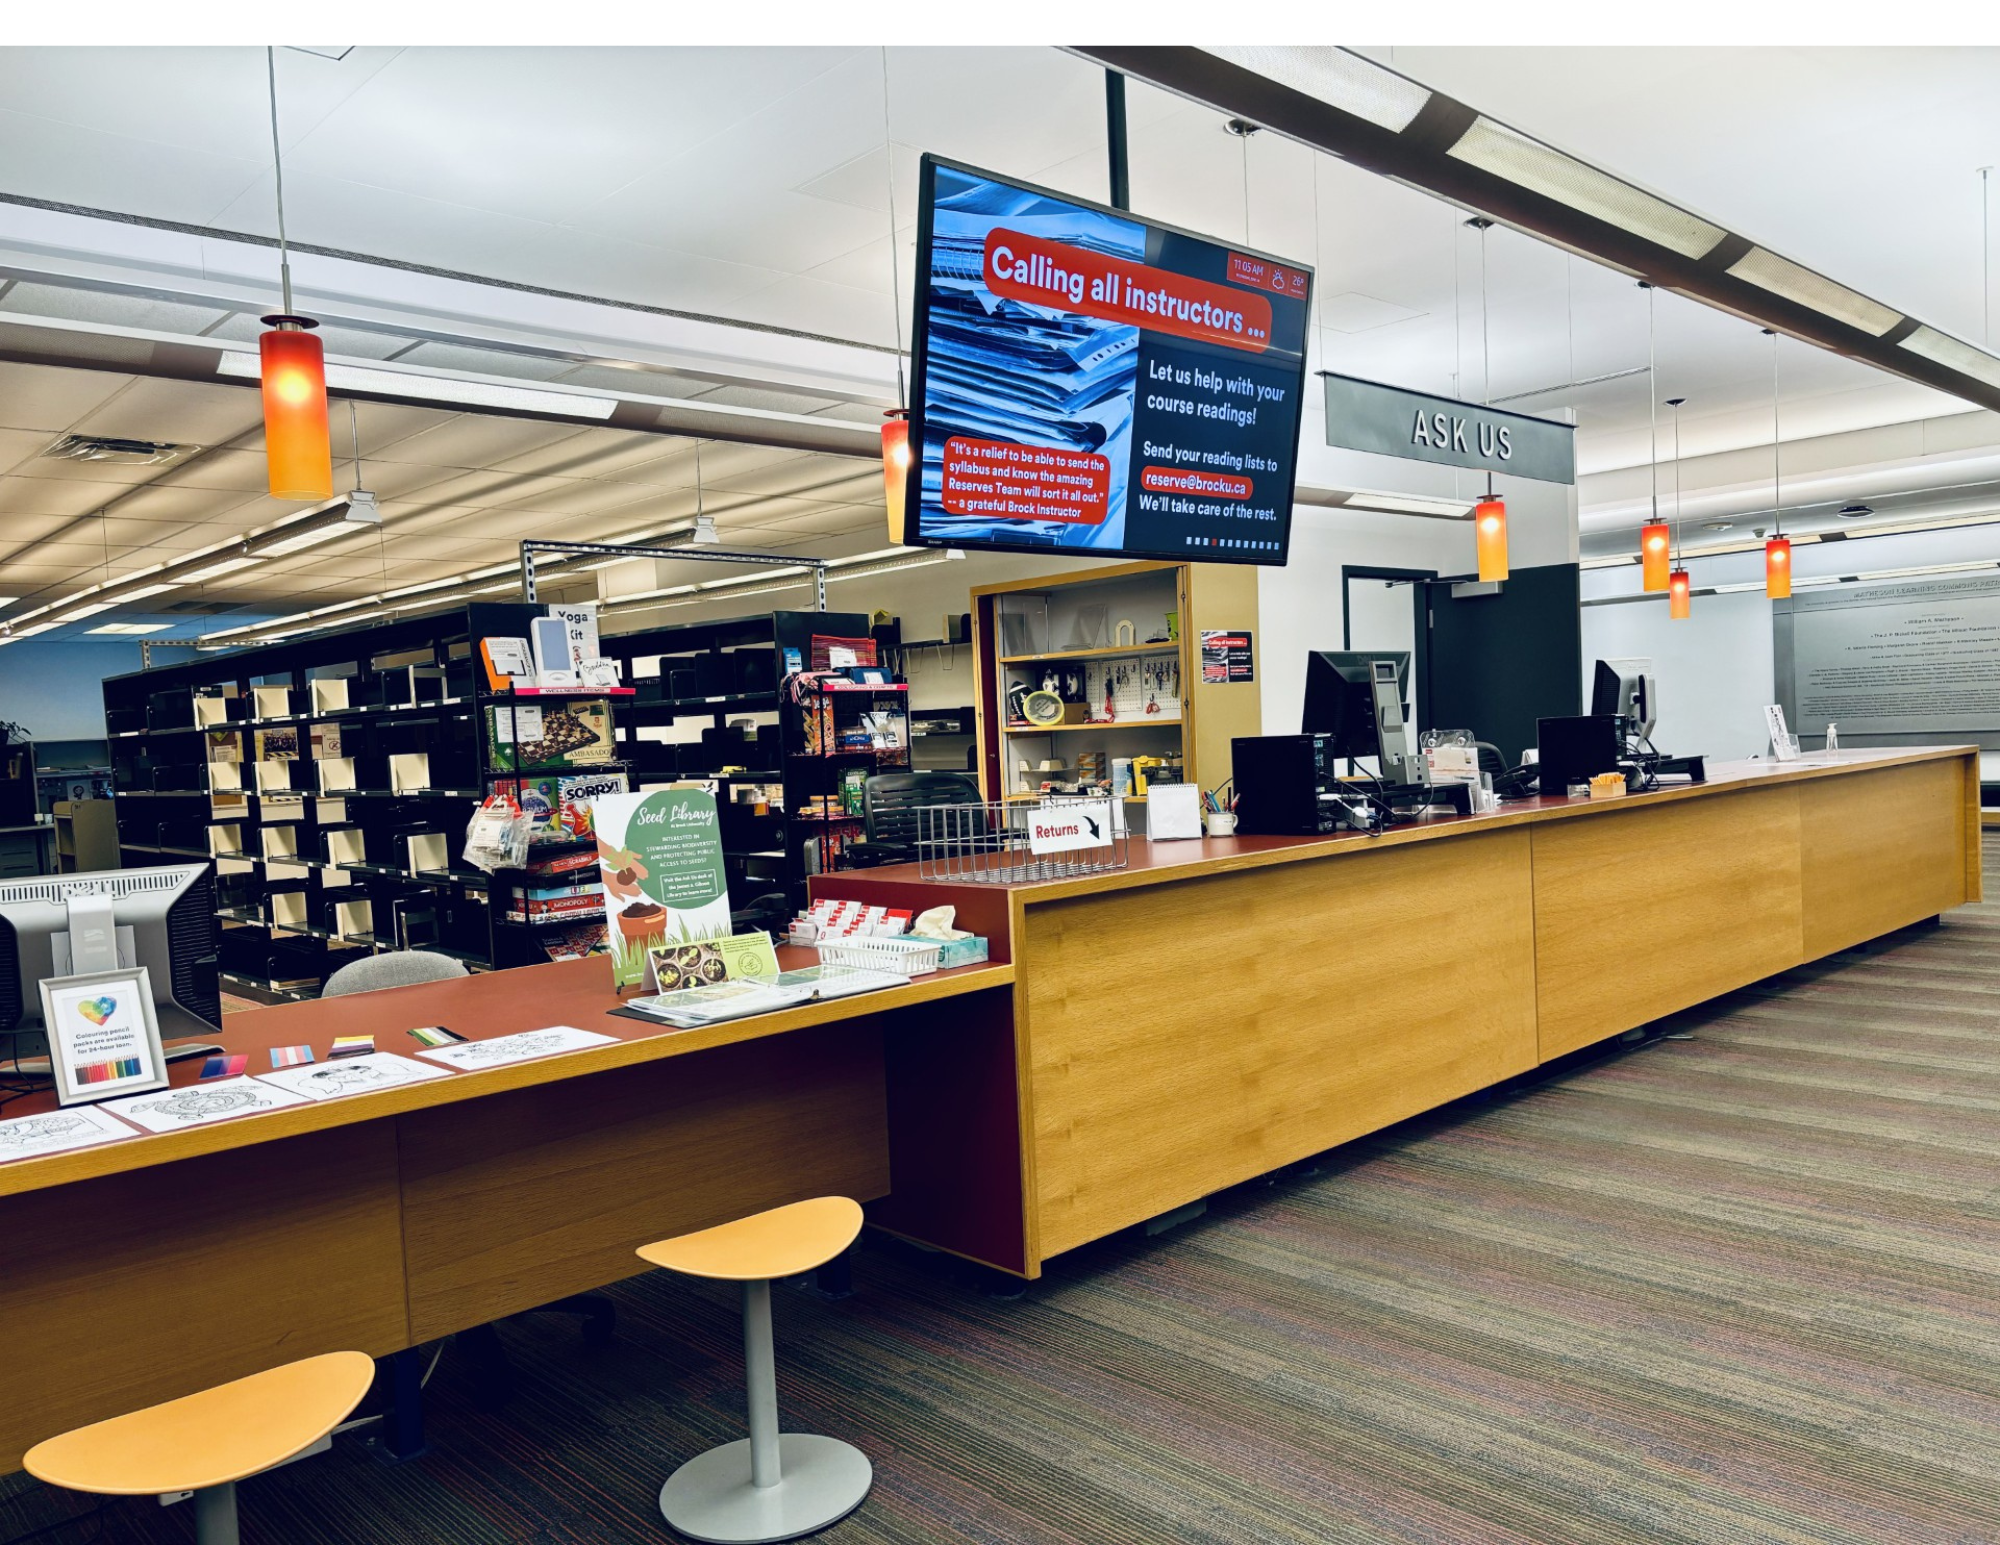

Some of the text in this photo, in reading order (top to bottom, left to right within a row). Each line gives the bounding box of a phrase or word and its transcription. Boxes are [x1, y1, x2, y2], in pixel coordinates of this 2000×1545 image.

[1252, 264, 1264, 276] AM
[991, 246, 1084, 304] Calling
[1091, 272, 1119, 305] all
[1125, 277, 1243, 334] instructors
[1150, 359, 1285, 402] Let us help with your
[1147, 394, 1257, 427] course readings!
[1411, 409, 1512, 460] ASK US
[973, 448, 979, 456] a
[981, 447, 1008, 460] relief
[1009, 451, 1018, 461] to
[1021, 451, 1033, 463] be
[1035, 453, 1054, 466] able
[1056, 456, 1065, 467] to
[1068, 456, 1088, 469] send
[1091, 459, 1104, 471] the
[1143, 440, 1278, 473] Send your reading lists to
[949, 461, 1094, 488] syllabus and know the amazing
[1146, 473, 1246, 495] reserve@brocku.ca
[949, 478, 993, 493] Reserves
[995, 482, 1021, 496] Team
[1023, 485, 1041, 498] will
[1042, 488, 1060, 500] sort
[1062, 489, 1069, 500] it
[1070, 490, 1081, 501] all
[959, 500, 965, 508] a
[966, 500, 1006, 511] grateful
[1008, 501, 1035, 514] Brock
[1037, 504, 1082, 518] Instructor
[1171, 498, 1196, 514] take
[1198, 503, 1220, 517] care
[1222, 503, 1235, 517] of
[1236, 504, 1253, 519] the
[1255, 507, 1277, 521] rest.
[1896, 584, 1936, 594] LEARNING
[1937, 580, 1979, 591] COMMONS
[557, 610, 588, 624] Yoga
[566, 781, 620, 801] SORRY!
[637, 801, 716, 826] Seed Library
[662, 834, 692, 842] INTERESTED
[1035, 823, 1079, 839] Returns
[646, 840, 717, 852] STEWARDING BIODIVERSITY
[663, 850, 696, 859] PROTECTING
[553, 899, 588, 908] MONOPOLY
[73, 1040, 93, 1048] packs
[105, 1033, 135, 1042] available
[75, 1026, 130, 1040] Colouring pencil
[88, 1044, 115, 1053] 24-hour
